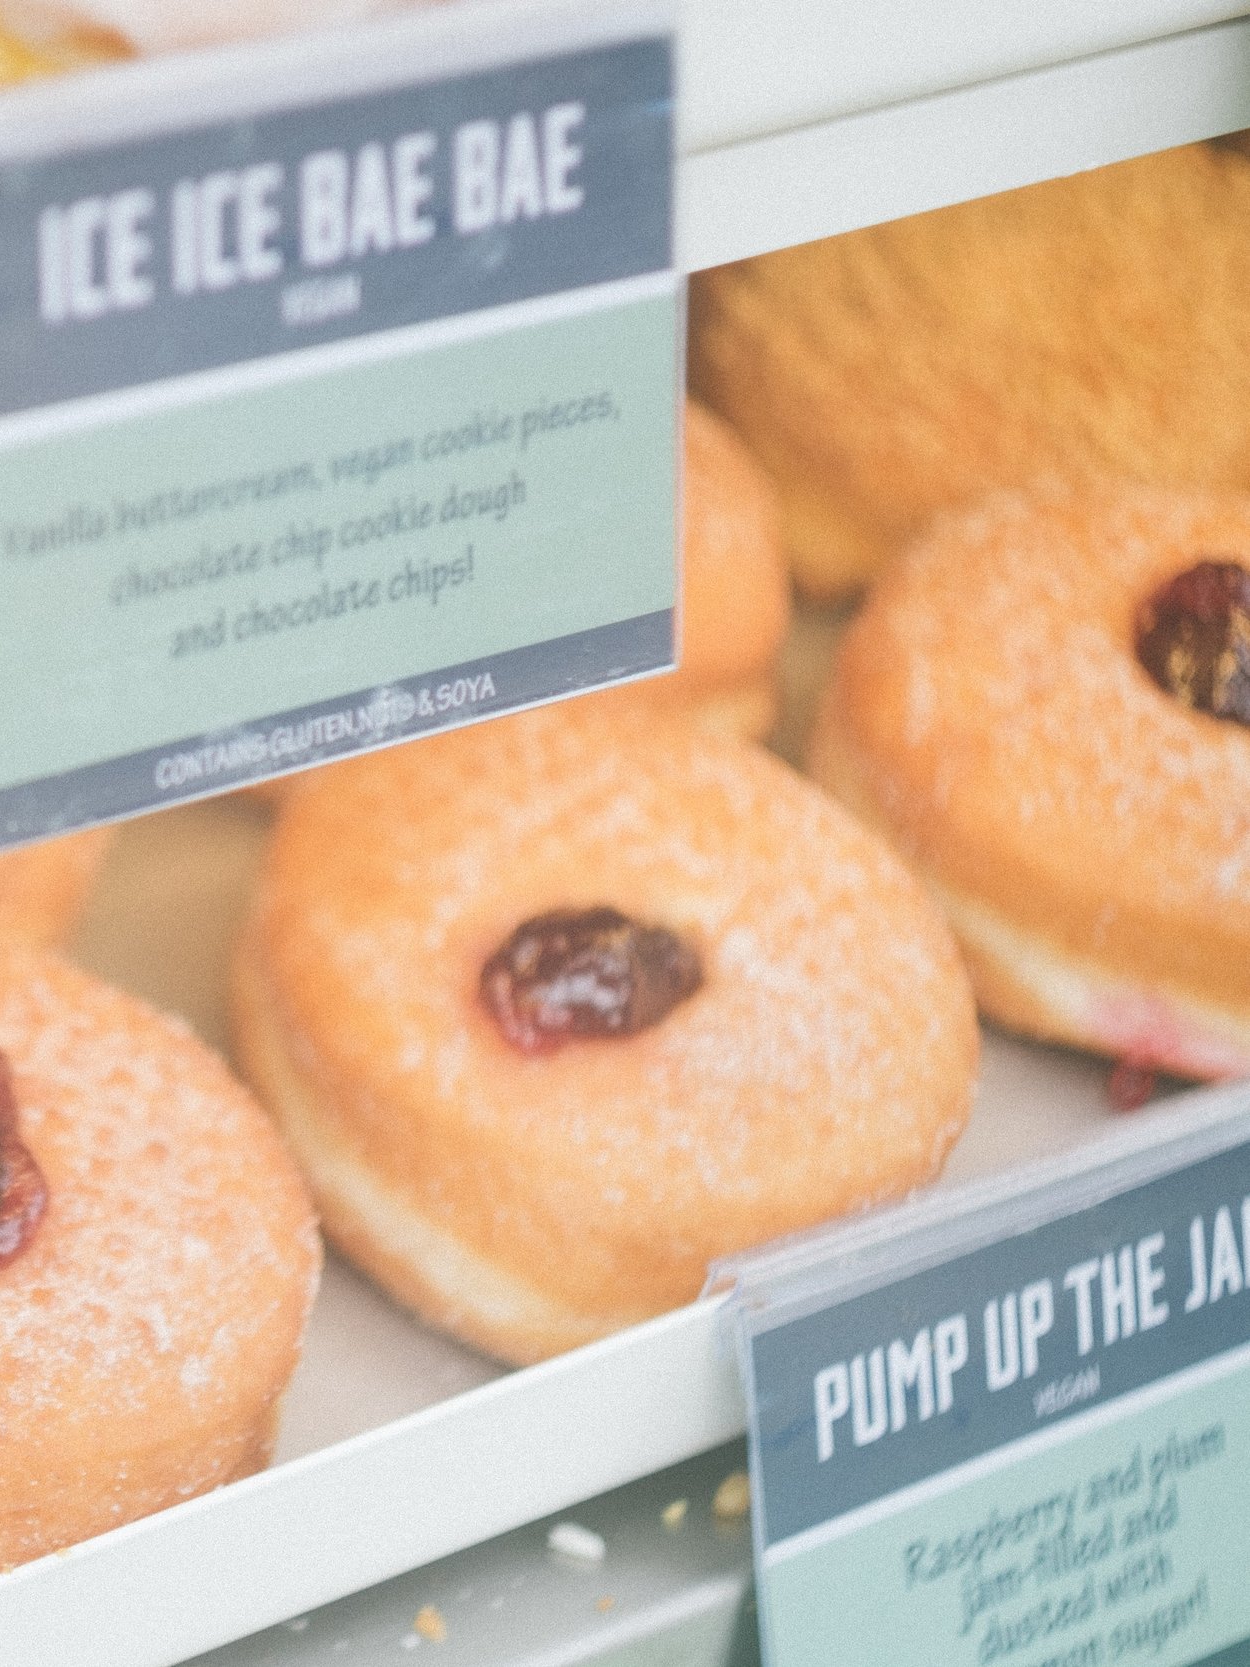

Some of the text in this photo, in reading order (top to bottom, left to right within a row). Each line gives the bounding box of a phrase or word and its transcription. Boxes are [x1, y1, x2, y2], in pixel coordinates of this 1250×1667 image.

[37, 102, 587, 323] ICE ICE BAE BAE
[328, 436, 415, 486] vegan
[421, 410, 512, 461] cookie
[520, 390, 622, 452] pieces,
[109, 469, 527, 606] chocolate chip cookie dough
[172, 543, 476, 658] and chocolate chips!
[154, 732, 268, 790] CONTAINS
[417, 687, 437, 718] &
[436, 672, 497, 713] SOYA
[813, 1193, 1250, 1464] PUMP UP THE JA
[903, 1424, 1226, 1592] Raspberry and plum
[1118, 1479, 1179, 1549] and
[979, 1571, 1096, 1665] dusted
[1102, 1544, 1173, 1606] with
